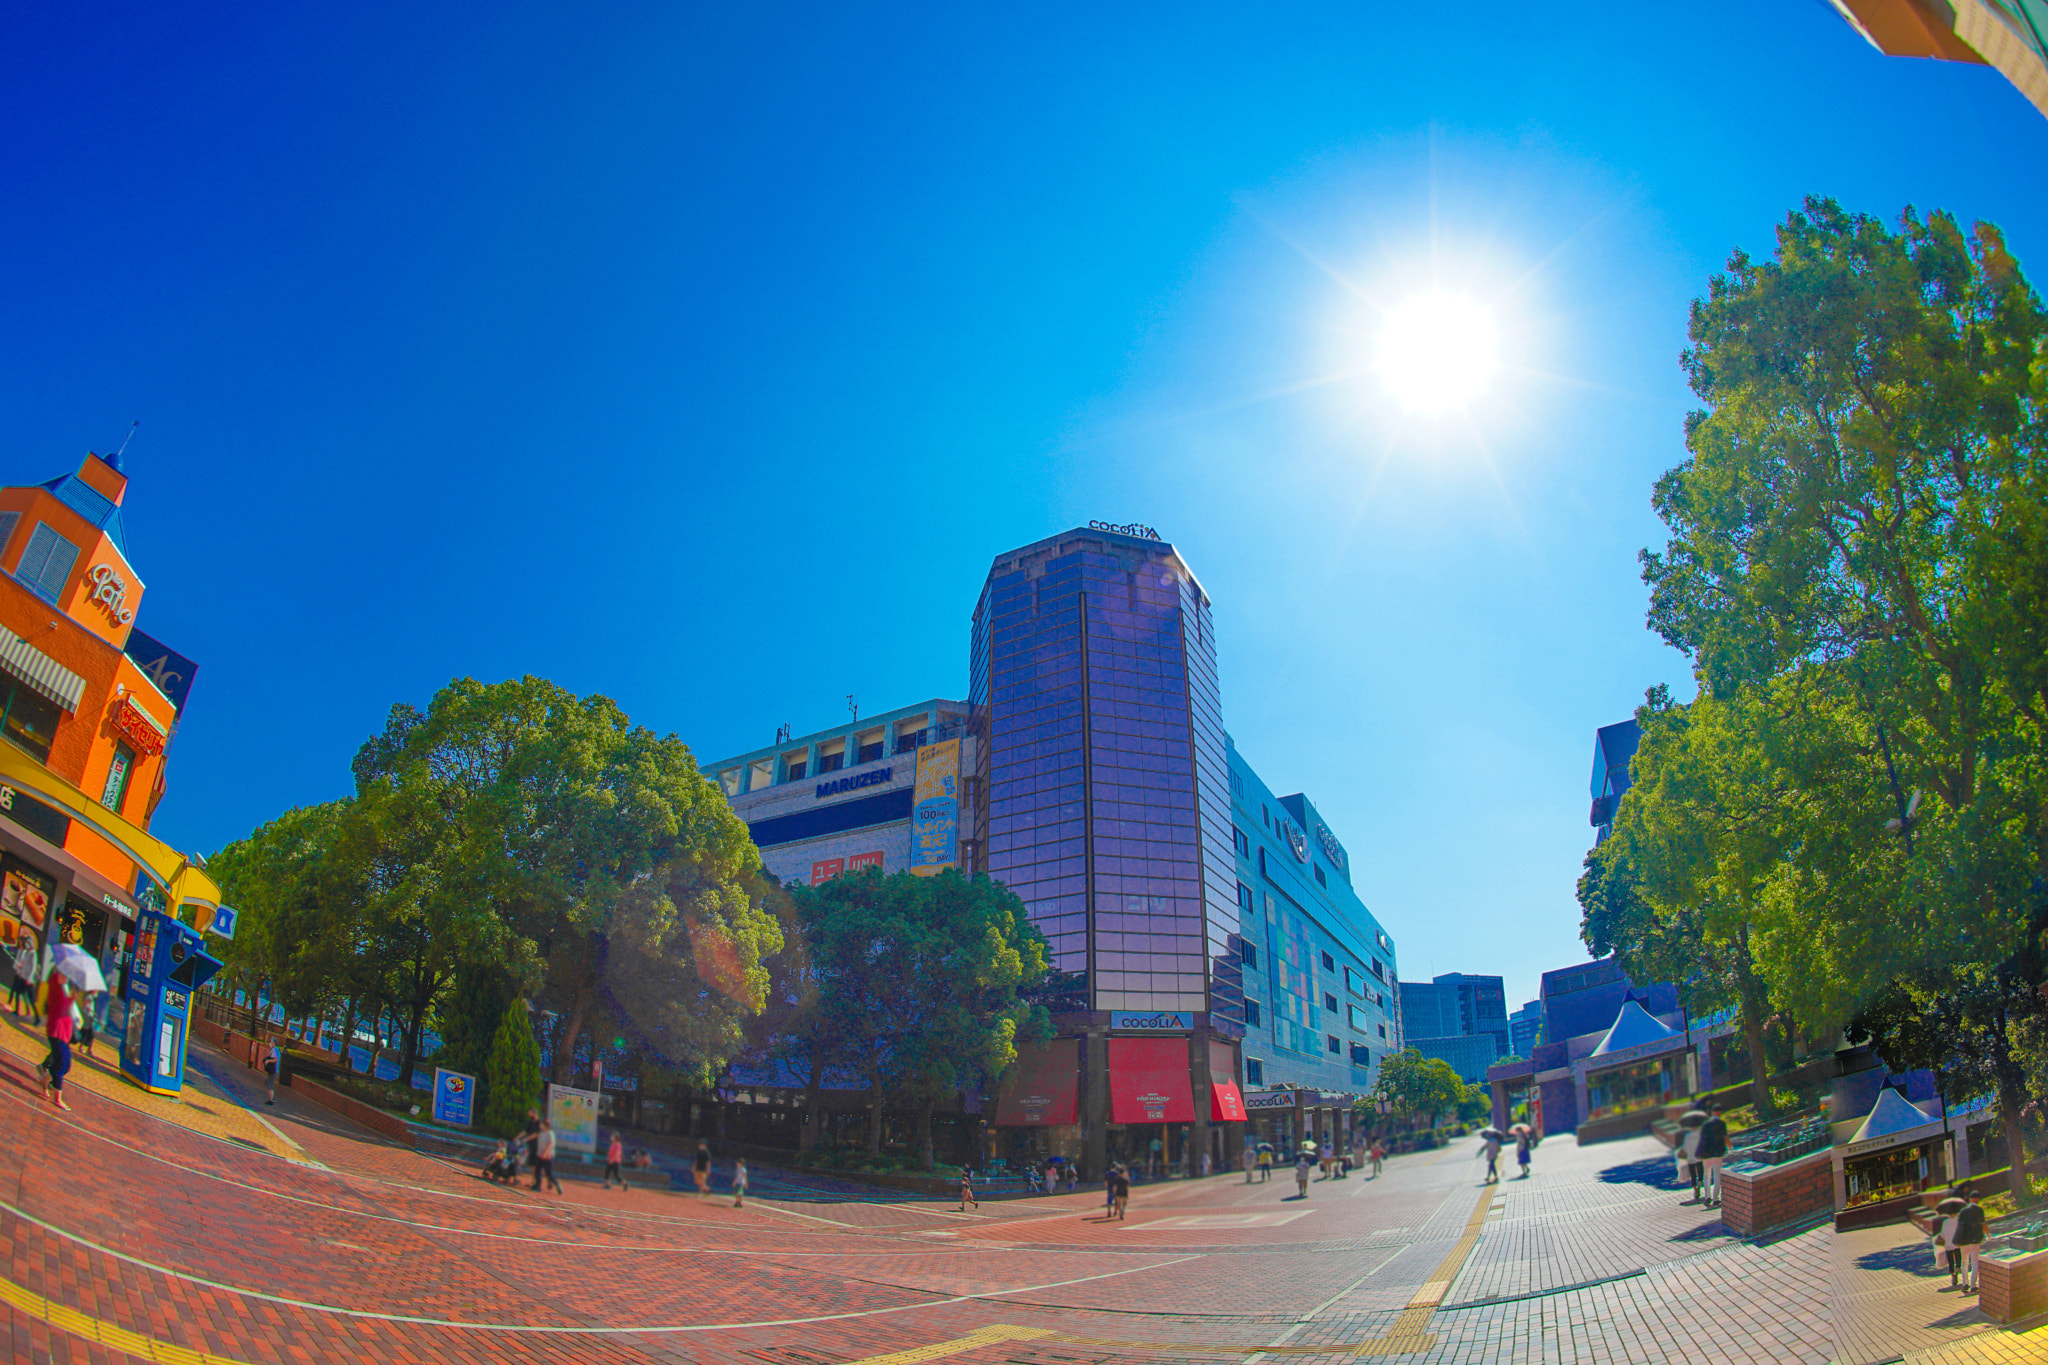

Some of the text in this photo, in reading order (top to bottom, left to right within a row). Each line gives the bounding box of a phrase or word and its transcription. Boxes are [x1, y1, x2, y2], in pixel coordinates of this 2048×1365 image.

[1089, 520, 1162, 541] COCOLIA
[91, 563, 131, 624] Patio
[122, 708, 163, 758] サイゼリヤ
[815, 767, 893, 799] MARUZEN
[1122, 1013, 1184, 1028] COCOLIA
[1247, 1094, 1293, 1108] COCOLIA
